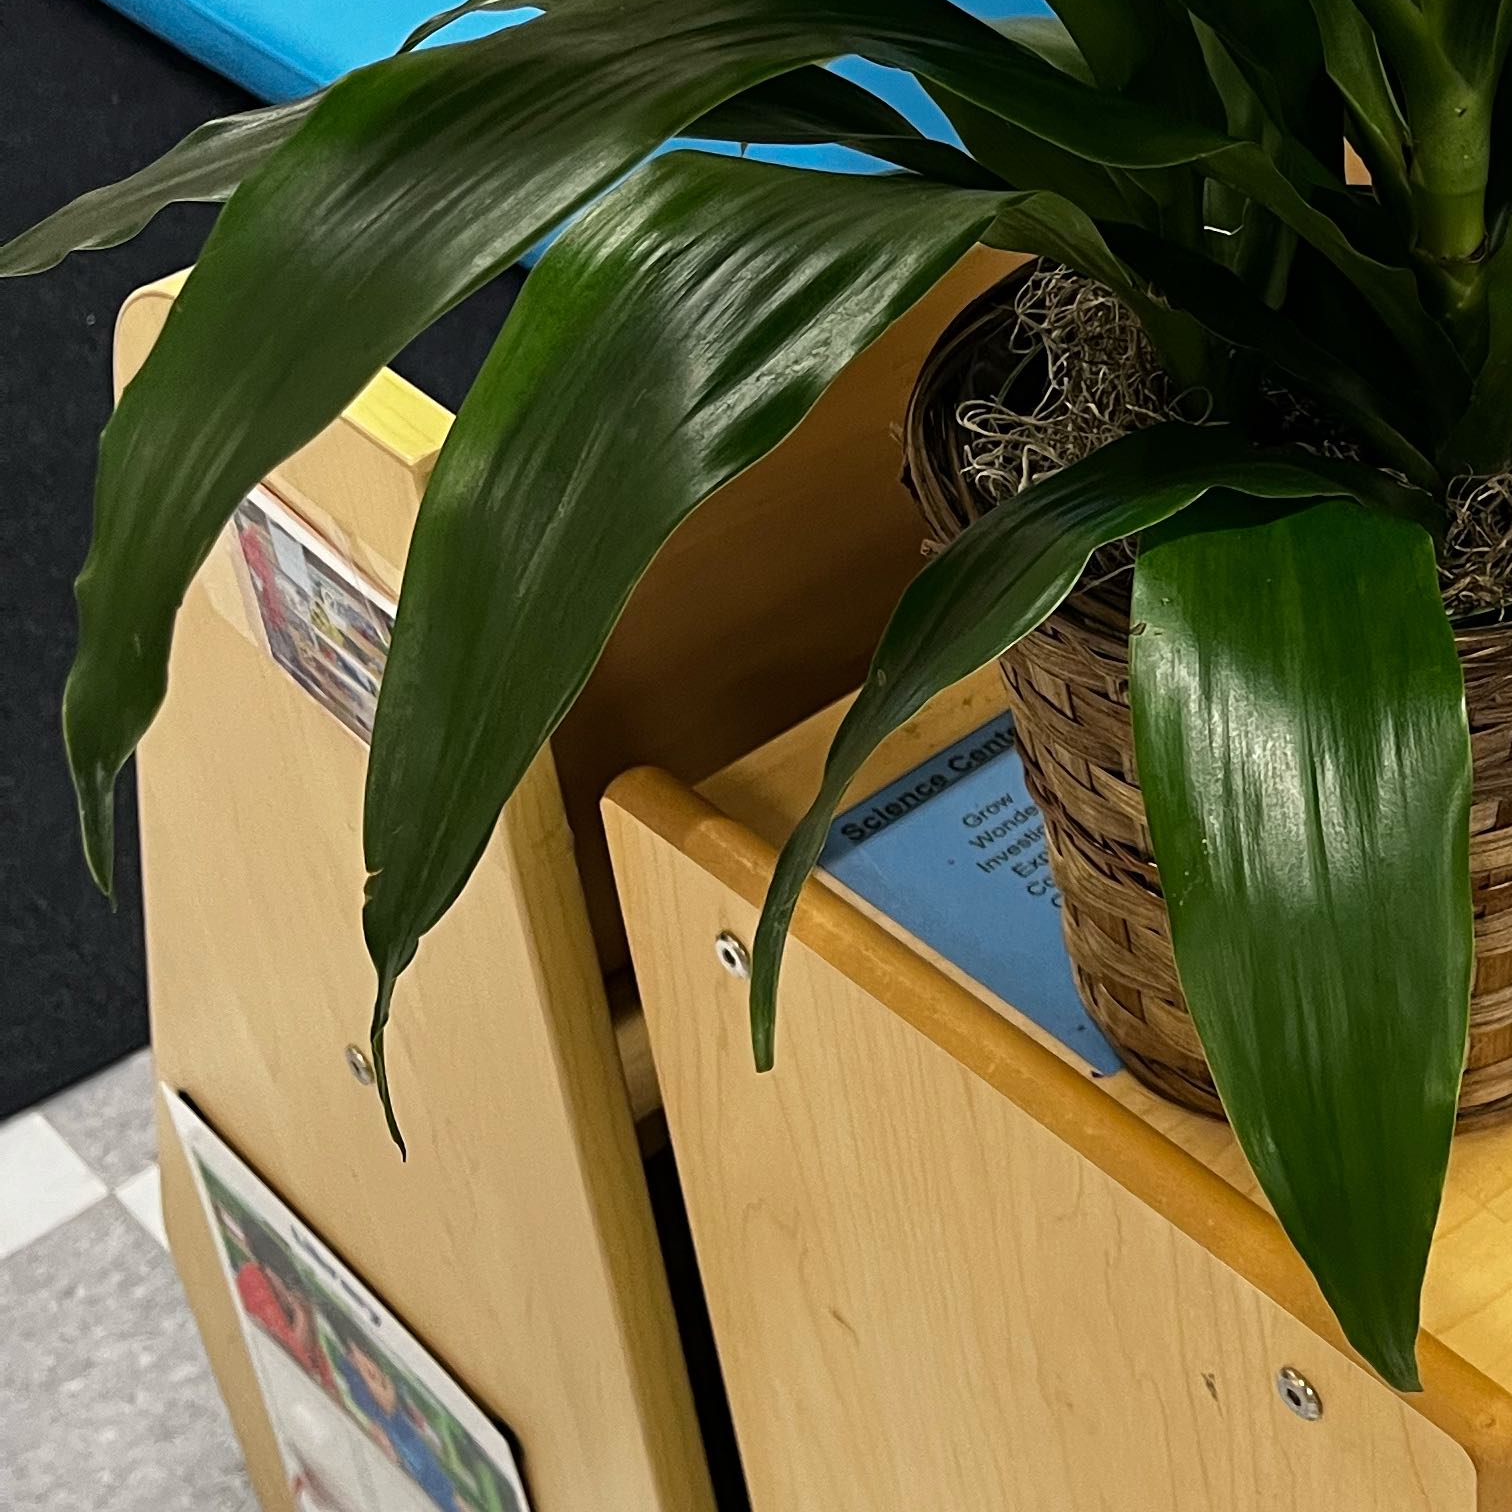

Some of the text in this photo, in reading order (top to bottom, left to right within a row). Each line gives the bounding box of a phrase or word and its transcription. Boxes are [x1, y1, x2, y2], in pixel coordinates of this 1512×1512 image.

[840, 727, 1016, 843] Science Cent
[962, 791, 1014, 829] Grow
[968, 804, 1040, 850] Wonde
[976, 825, 1045, 875] Investi
